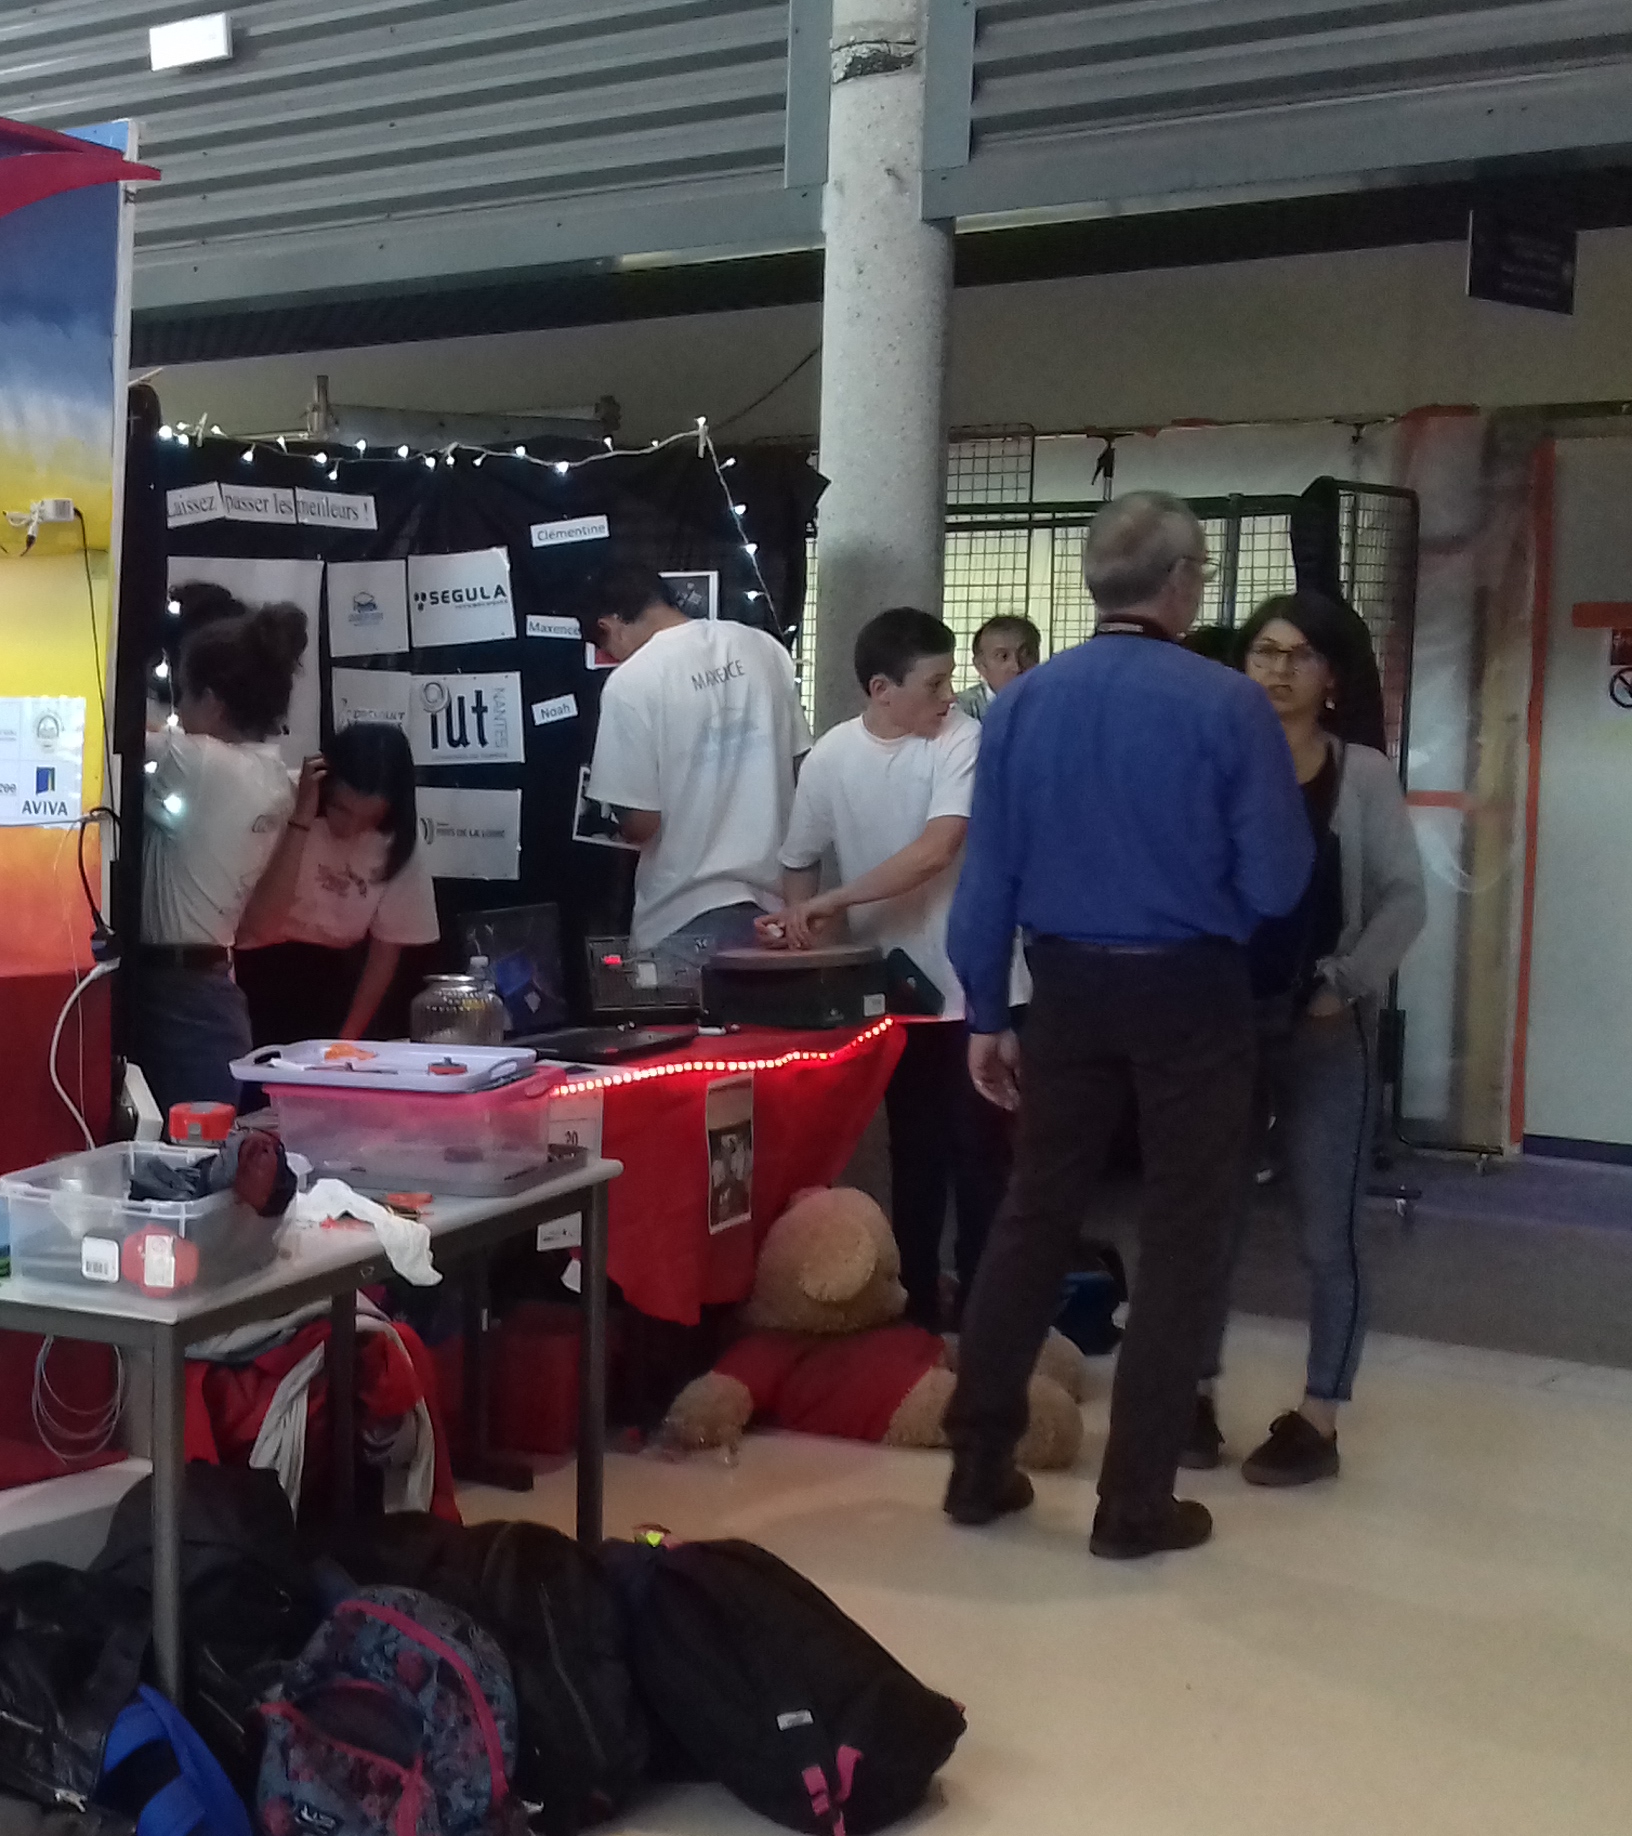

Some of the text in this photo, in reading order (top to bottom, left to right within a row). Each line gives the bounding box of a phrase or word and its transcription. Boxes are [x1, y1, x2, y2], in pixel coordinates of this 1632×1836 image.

[224, 495, 269, 513] passer
[273, 493, 294, 514] les
[429, 583, 507, 606] SEGULA
[528, 621, 581, 636] Maxence
[423, 682, 490, 750] iut
[539, 700, 573, 721] Noah
[21, 799, 68, 817] AVIVA
